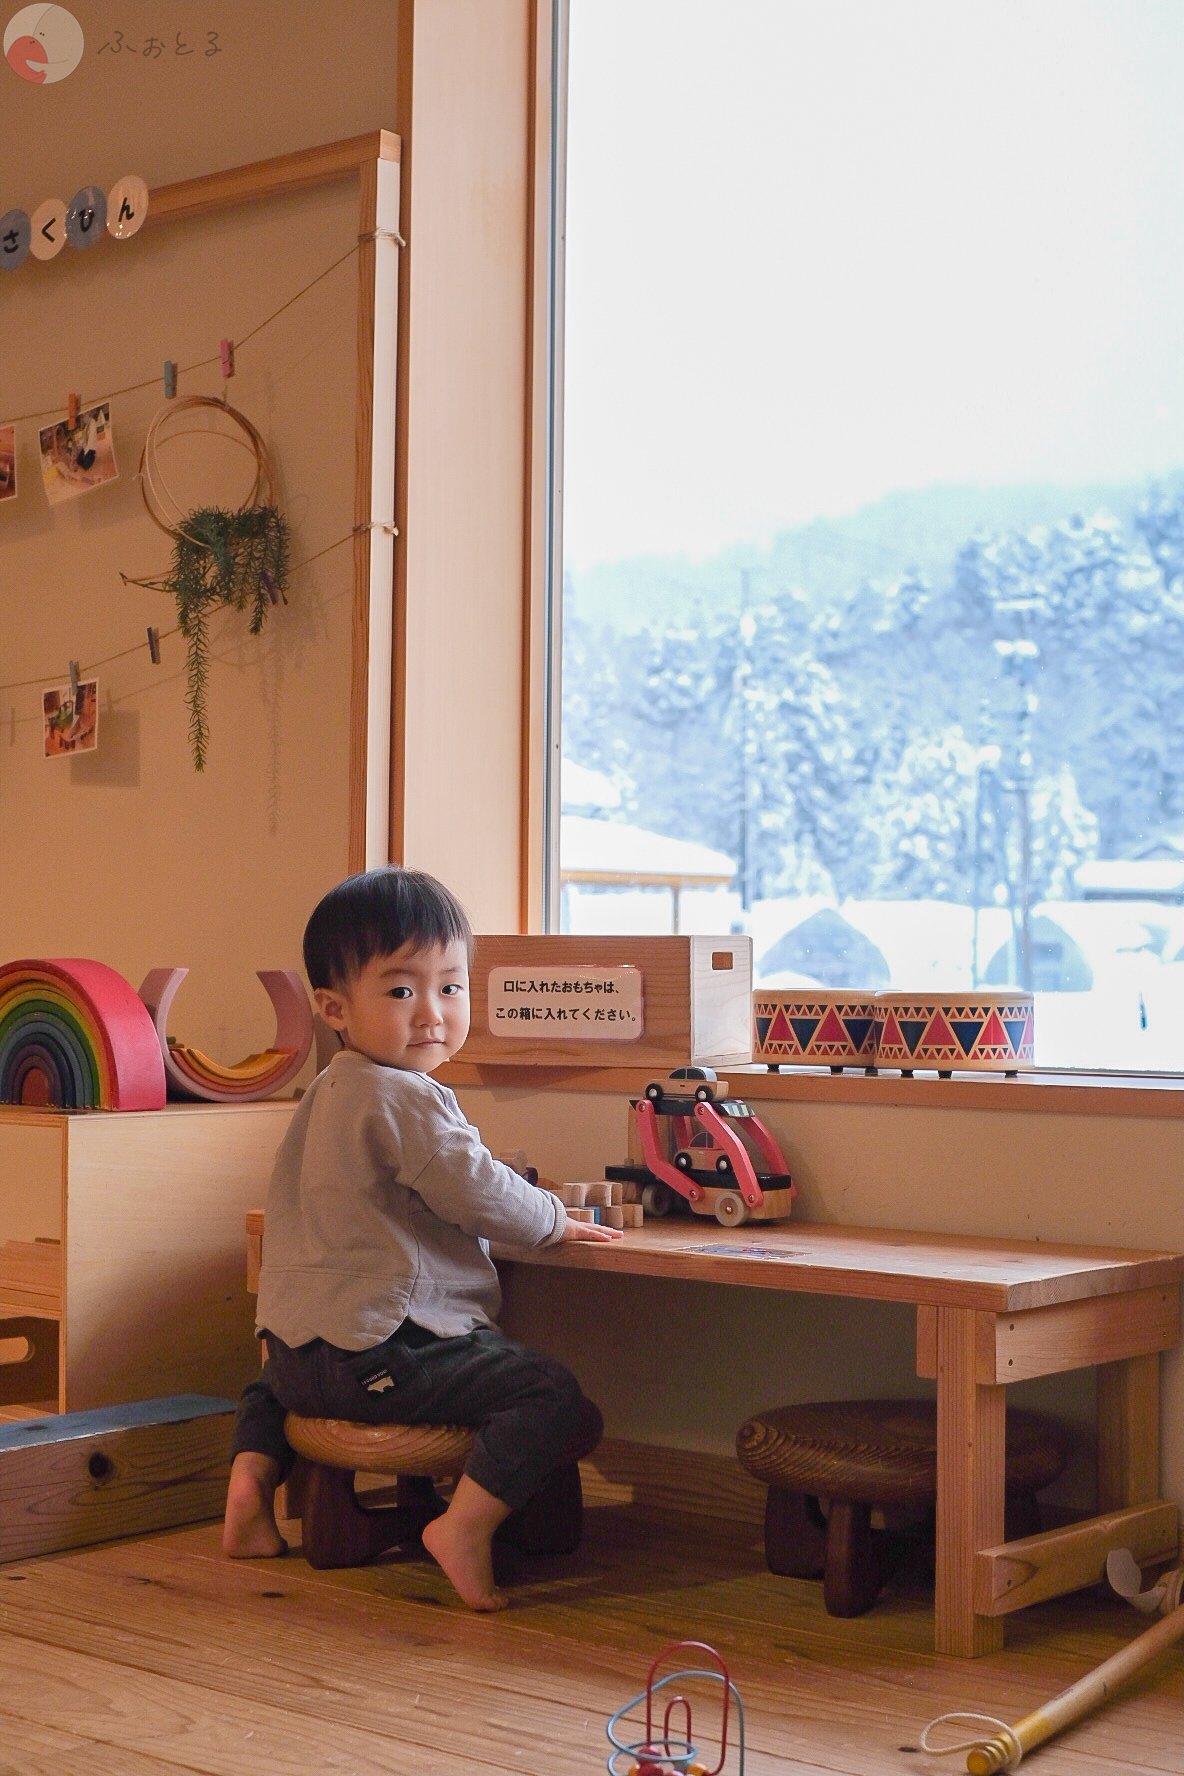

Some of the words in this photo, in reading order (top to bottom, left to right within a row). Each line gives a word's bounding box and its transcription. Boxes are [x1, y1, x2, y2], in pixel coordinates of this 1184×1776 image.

[503, 980, 620, 994] 口に入れたおもちゃは、
[495, 1007, 636, 1022] この箱に入れてください。
